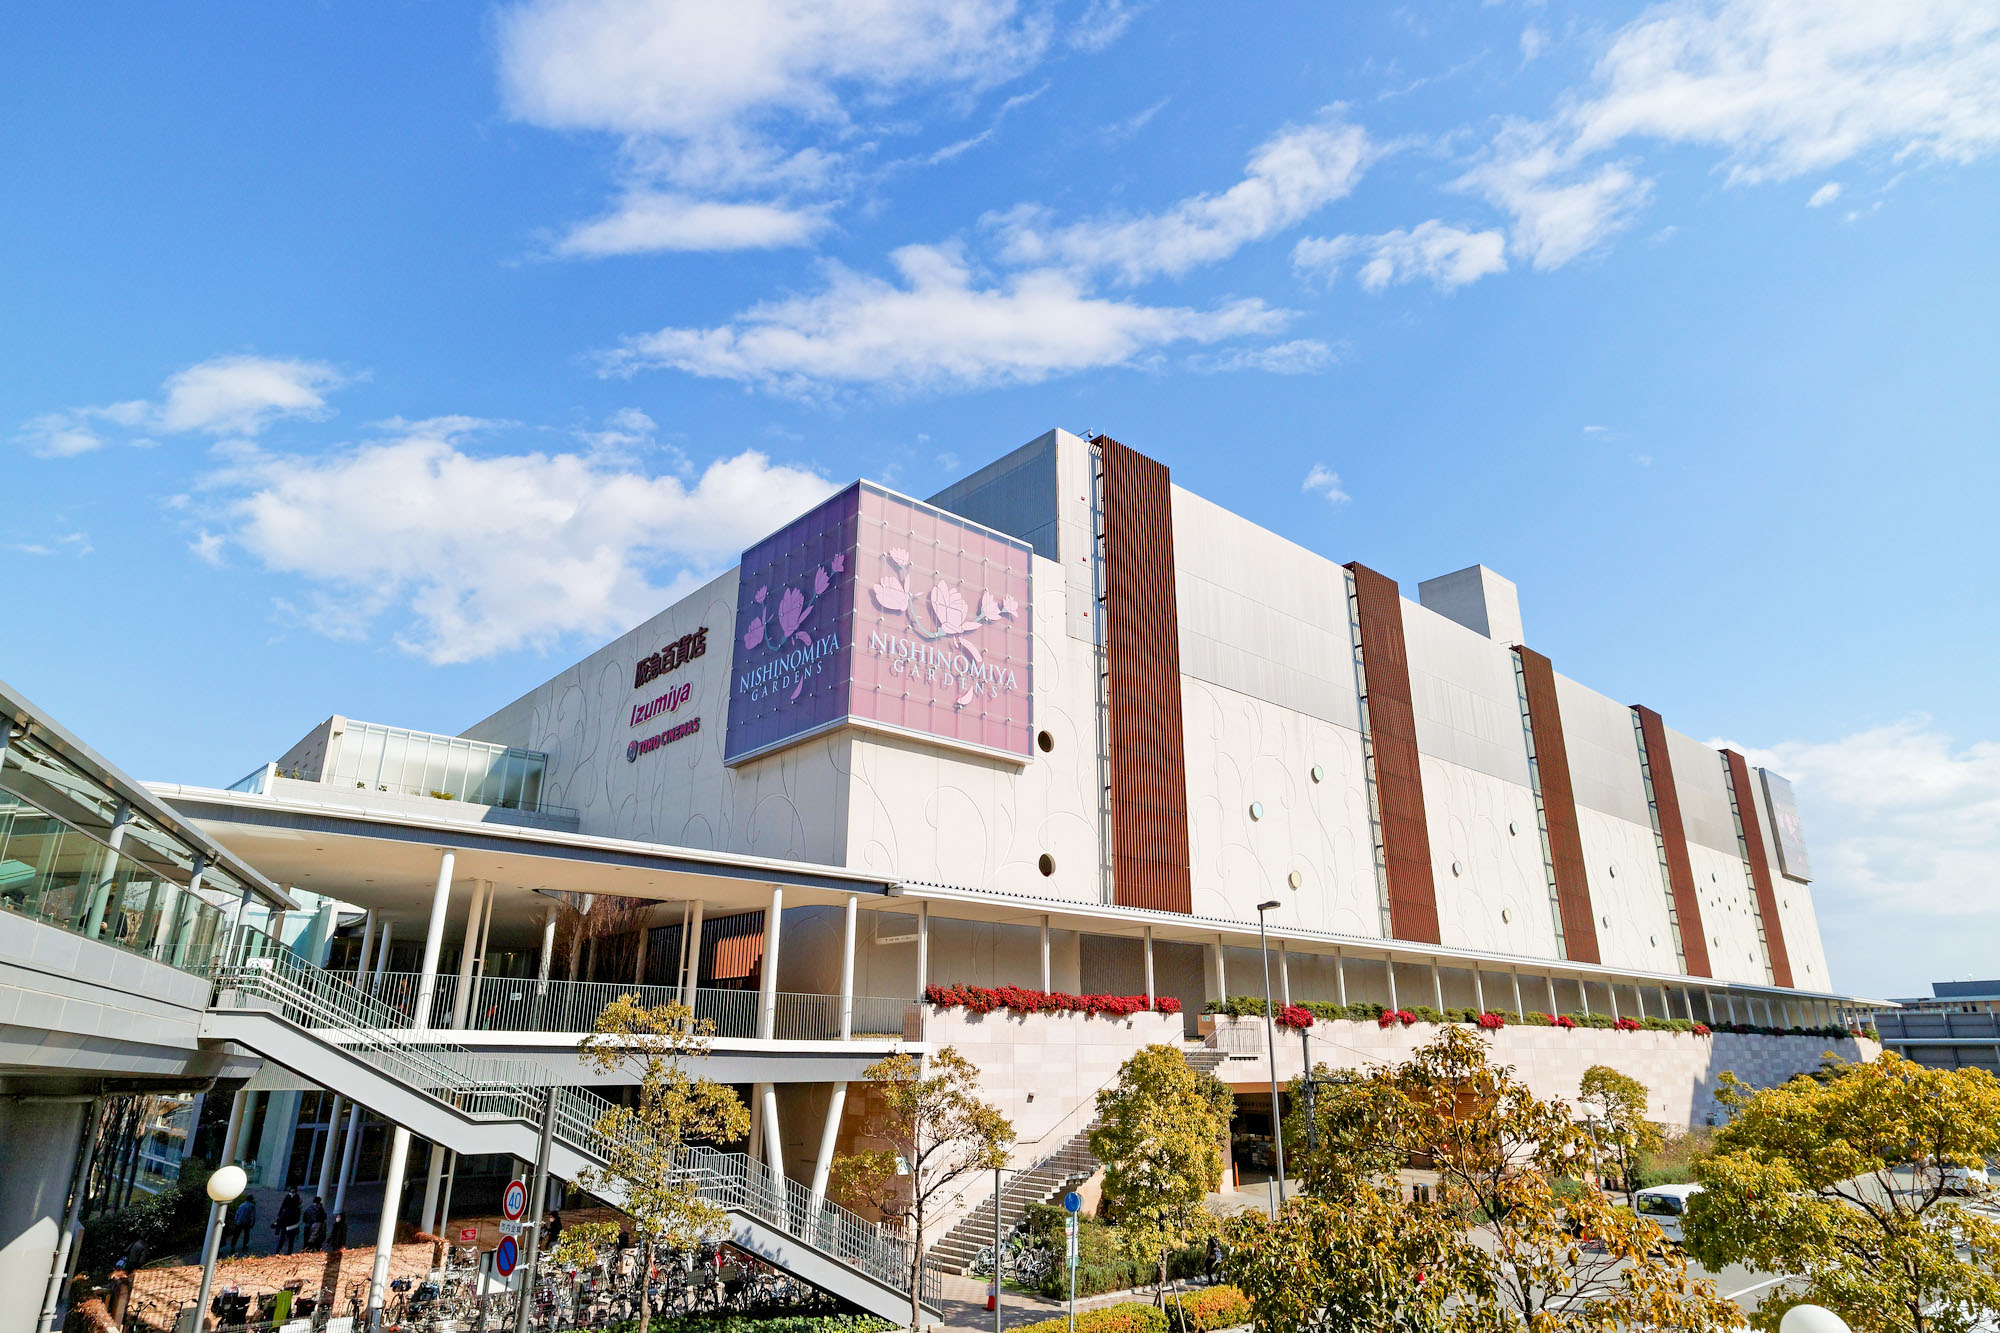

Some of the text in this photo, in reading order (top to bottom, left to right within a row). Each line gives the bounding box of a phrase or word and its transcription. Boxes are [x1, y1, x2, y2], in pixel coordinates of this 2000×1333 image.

[634, 626, 708, 689] 阪急百貨店
[740, 632, 839, 693] NISHINOMIYA
[871, 629, 1018, 689] NISHINOMIYA
[893, 659, 998, 698] GARDENS
[751, 660, 822, 701] GARDENS
[630, 682, 691, 727] Izumiya
[638, 717, 700, 756] TOHO CINEMAS
[508, 1192, 521, 1209] 40
